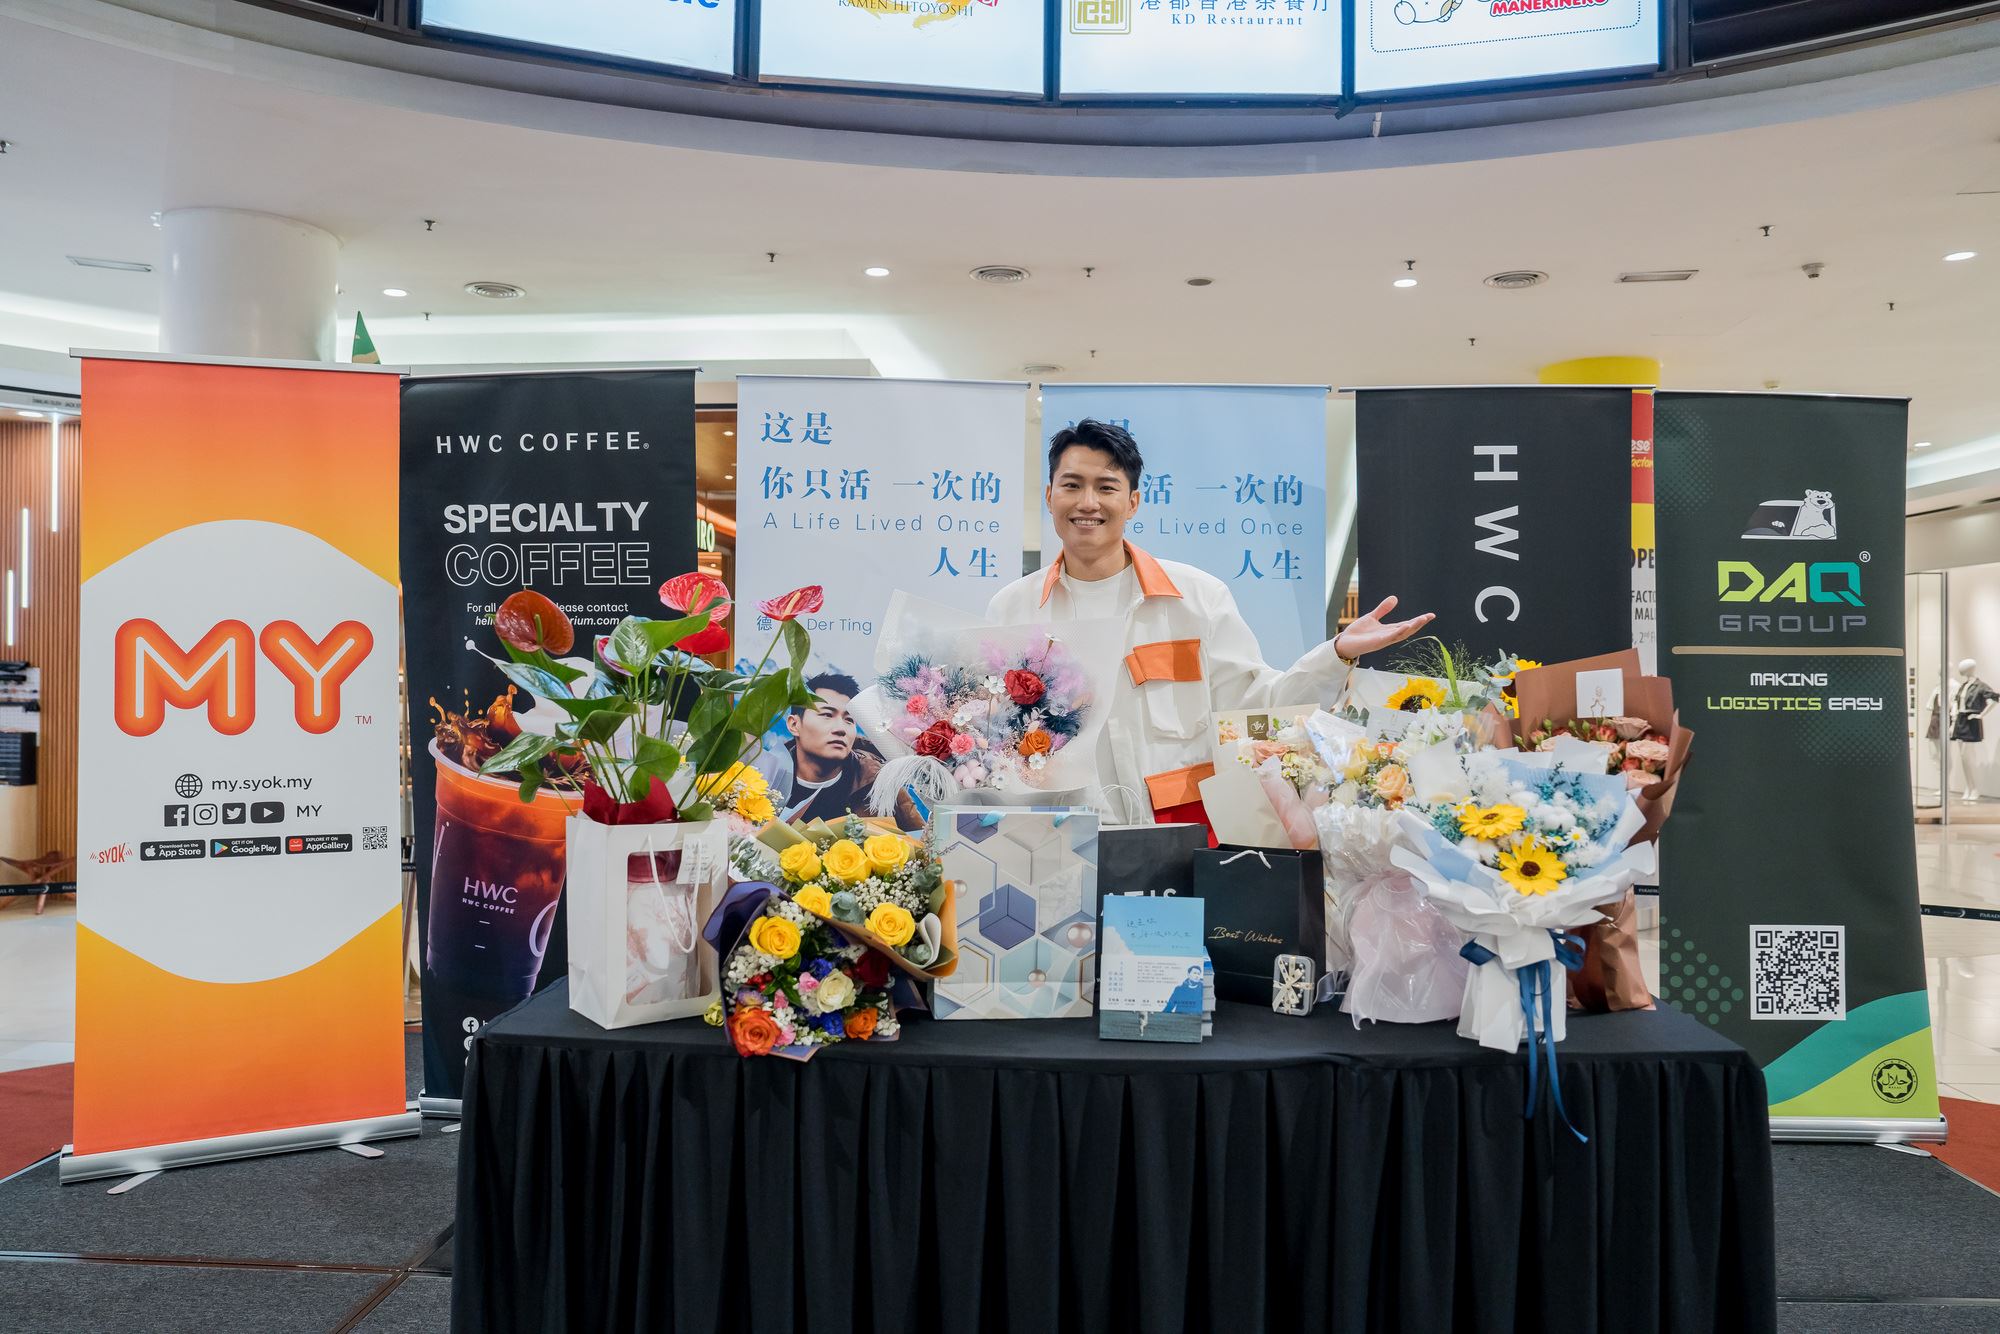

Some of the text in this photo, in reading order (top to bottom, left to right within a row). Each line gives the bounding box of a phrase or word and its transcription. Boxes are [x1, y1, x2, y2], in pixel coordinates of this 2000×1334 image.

[838, 0, 973, 16] RAMEN HITOYOSHI
[1172, 14, 1303, 25] KD Restaurant
[760, 411, 832, 445] 这是
[436, 431, 640, 454] HWC COFFEE
[760, 466, 1001, 504] 你只活 一次的
[1196, 473, 1303, 506] 一次的
[443, 502, 649, 533] SPECIALTY
[763, 512, 1000, 533] A Life Lived Once
[1160, 517, 1226, 534] Lived
[1241, 518, 1303, 535] Once
[1473, 445, 1520, 623] HWC
[445, 542, 651, 587] COFFEE
[929, 546, 998, 578] 人生
[1233, 550, 1302, 580] 人生
[1717, 561, 1866, 607] DAQ
[467, 603, 629, 612] For all lease contact
[807, 619, 834, 631] Der
[839, 618, 872, 635] Ting
[1719, 615, 1867, 632] GROUP
[114, 618, 374, 737] MY
[1750, 673, 1828, 687] MAKING
[1707, 697, 1883, 711] LOGISTICS EASY
[211, 776, 313, 791] my.syok.my
[296, 805, 322, 817] MY
[159, 849, 177, 857] App
[231, 844, 278, 854] Google Play
[306, 841, 349, 850] AppGallery
[463, 876, 518, 904] HWC
[462, 897, 515, 914] HWC COFFEE
[1208, 926, 1284, 944] Best Wishes
